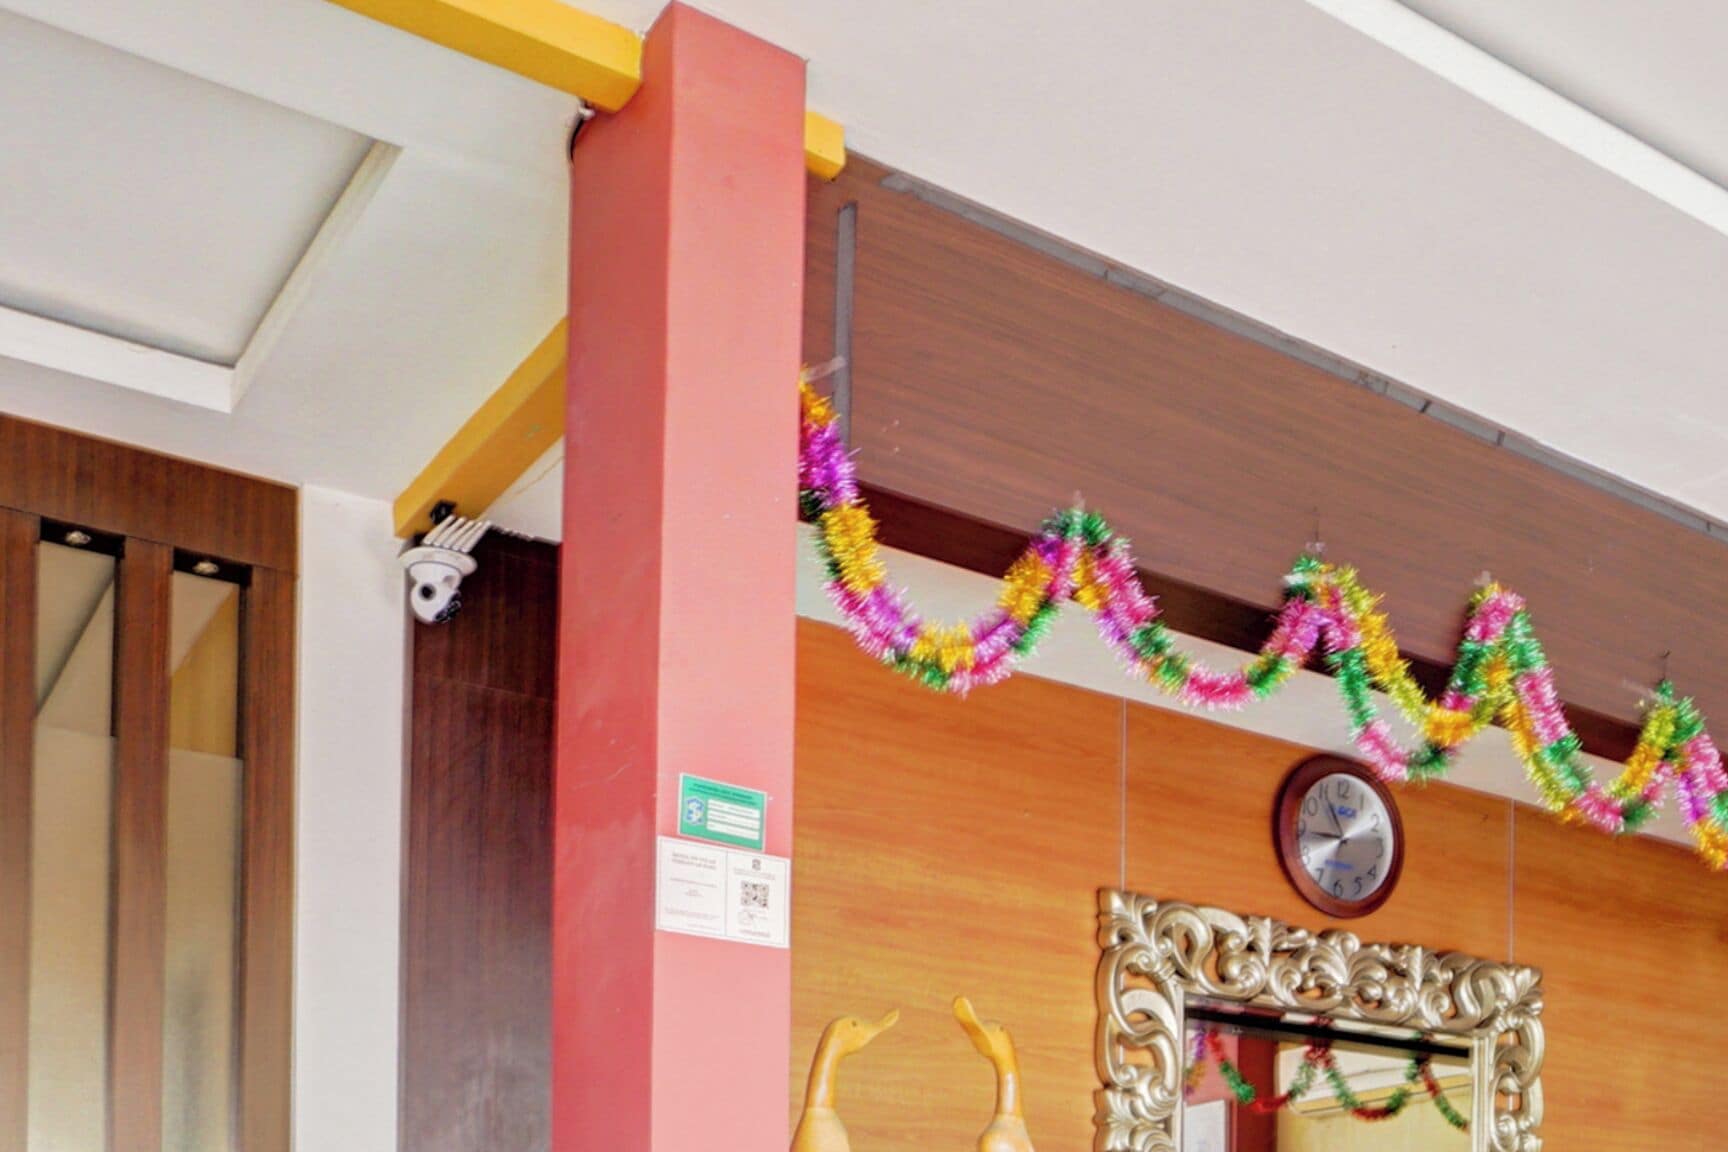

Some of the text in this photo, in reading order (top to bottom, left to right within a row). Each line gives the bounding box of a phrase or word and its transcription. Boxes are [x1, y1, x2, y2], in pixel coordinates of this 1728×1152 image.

[1336, 780, 1350, 800] 12
[1302, 795, 1318, 816] 10
[1371, 813, 1380, 833] 2
[1315, 867, 1325, 883] 7
[1367, 865, 1377, 880] 4
[1333, 880, 1344, 897] 6
[1353, 876, 1362, 896] 5
